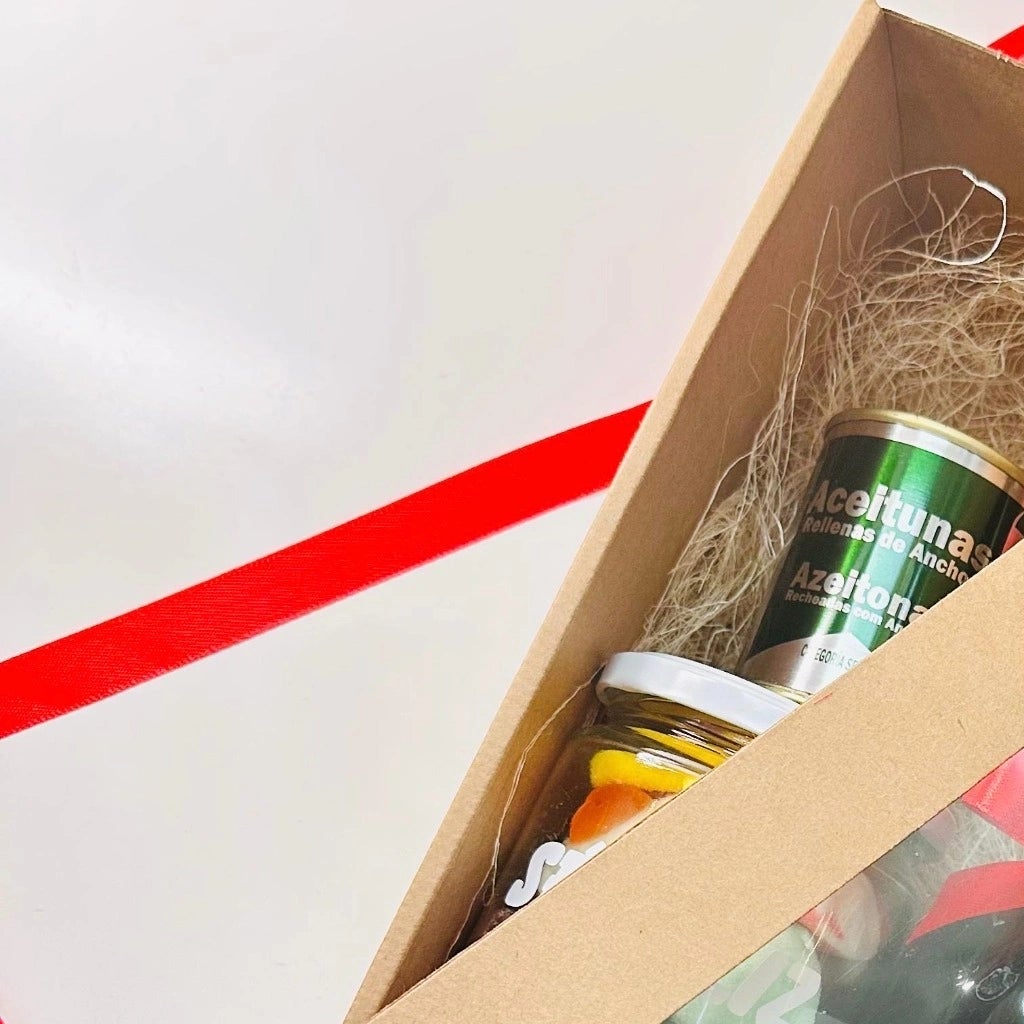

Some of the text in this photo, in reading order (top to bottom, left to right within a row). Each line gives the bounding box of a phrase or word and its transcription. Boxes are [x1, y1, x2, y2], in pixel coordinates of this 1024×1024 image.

[802, 517, 876, 542] Rellenas
[879, 532, 906, 553] de
[807, 481, 992, 571] Aceitunas
[786, 590, 850, 613] Recheadas
[852, 605, 883, 625] com
